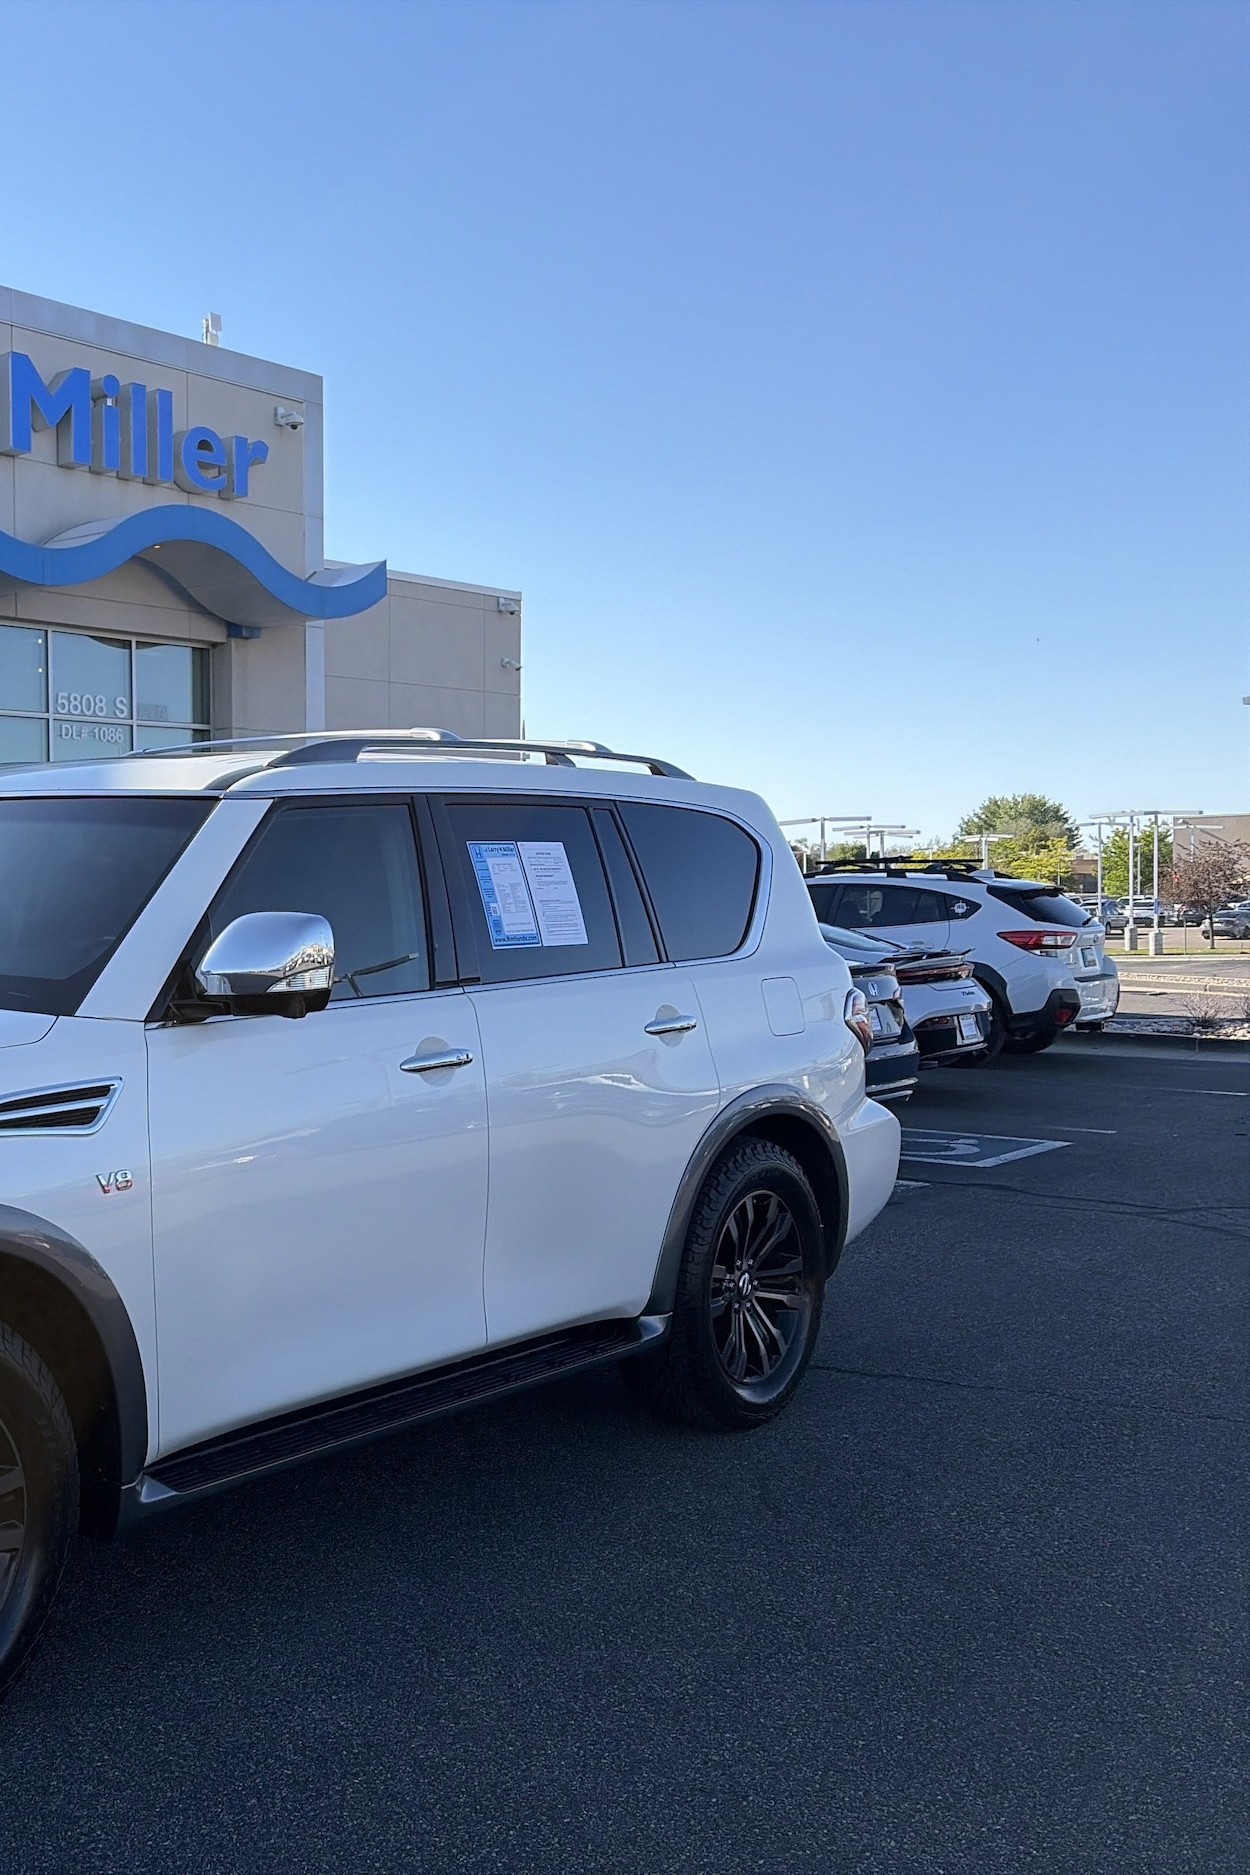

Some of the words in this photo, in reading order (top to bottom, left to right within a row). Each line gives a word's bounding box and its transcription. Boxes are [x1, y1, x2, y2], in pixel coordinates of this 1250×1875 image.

[57, 692, 107, 716] 5808
[115, 697, 127, 718] S
[62, 724, 88, 740] DL#
[94, 727, 124, 743] 1086
[96, 1169, 133, 1194] V8
